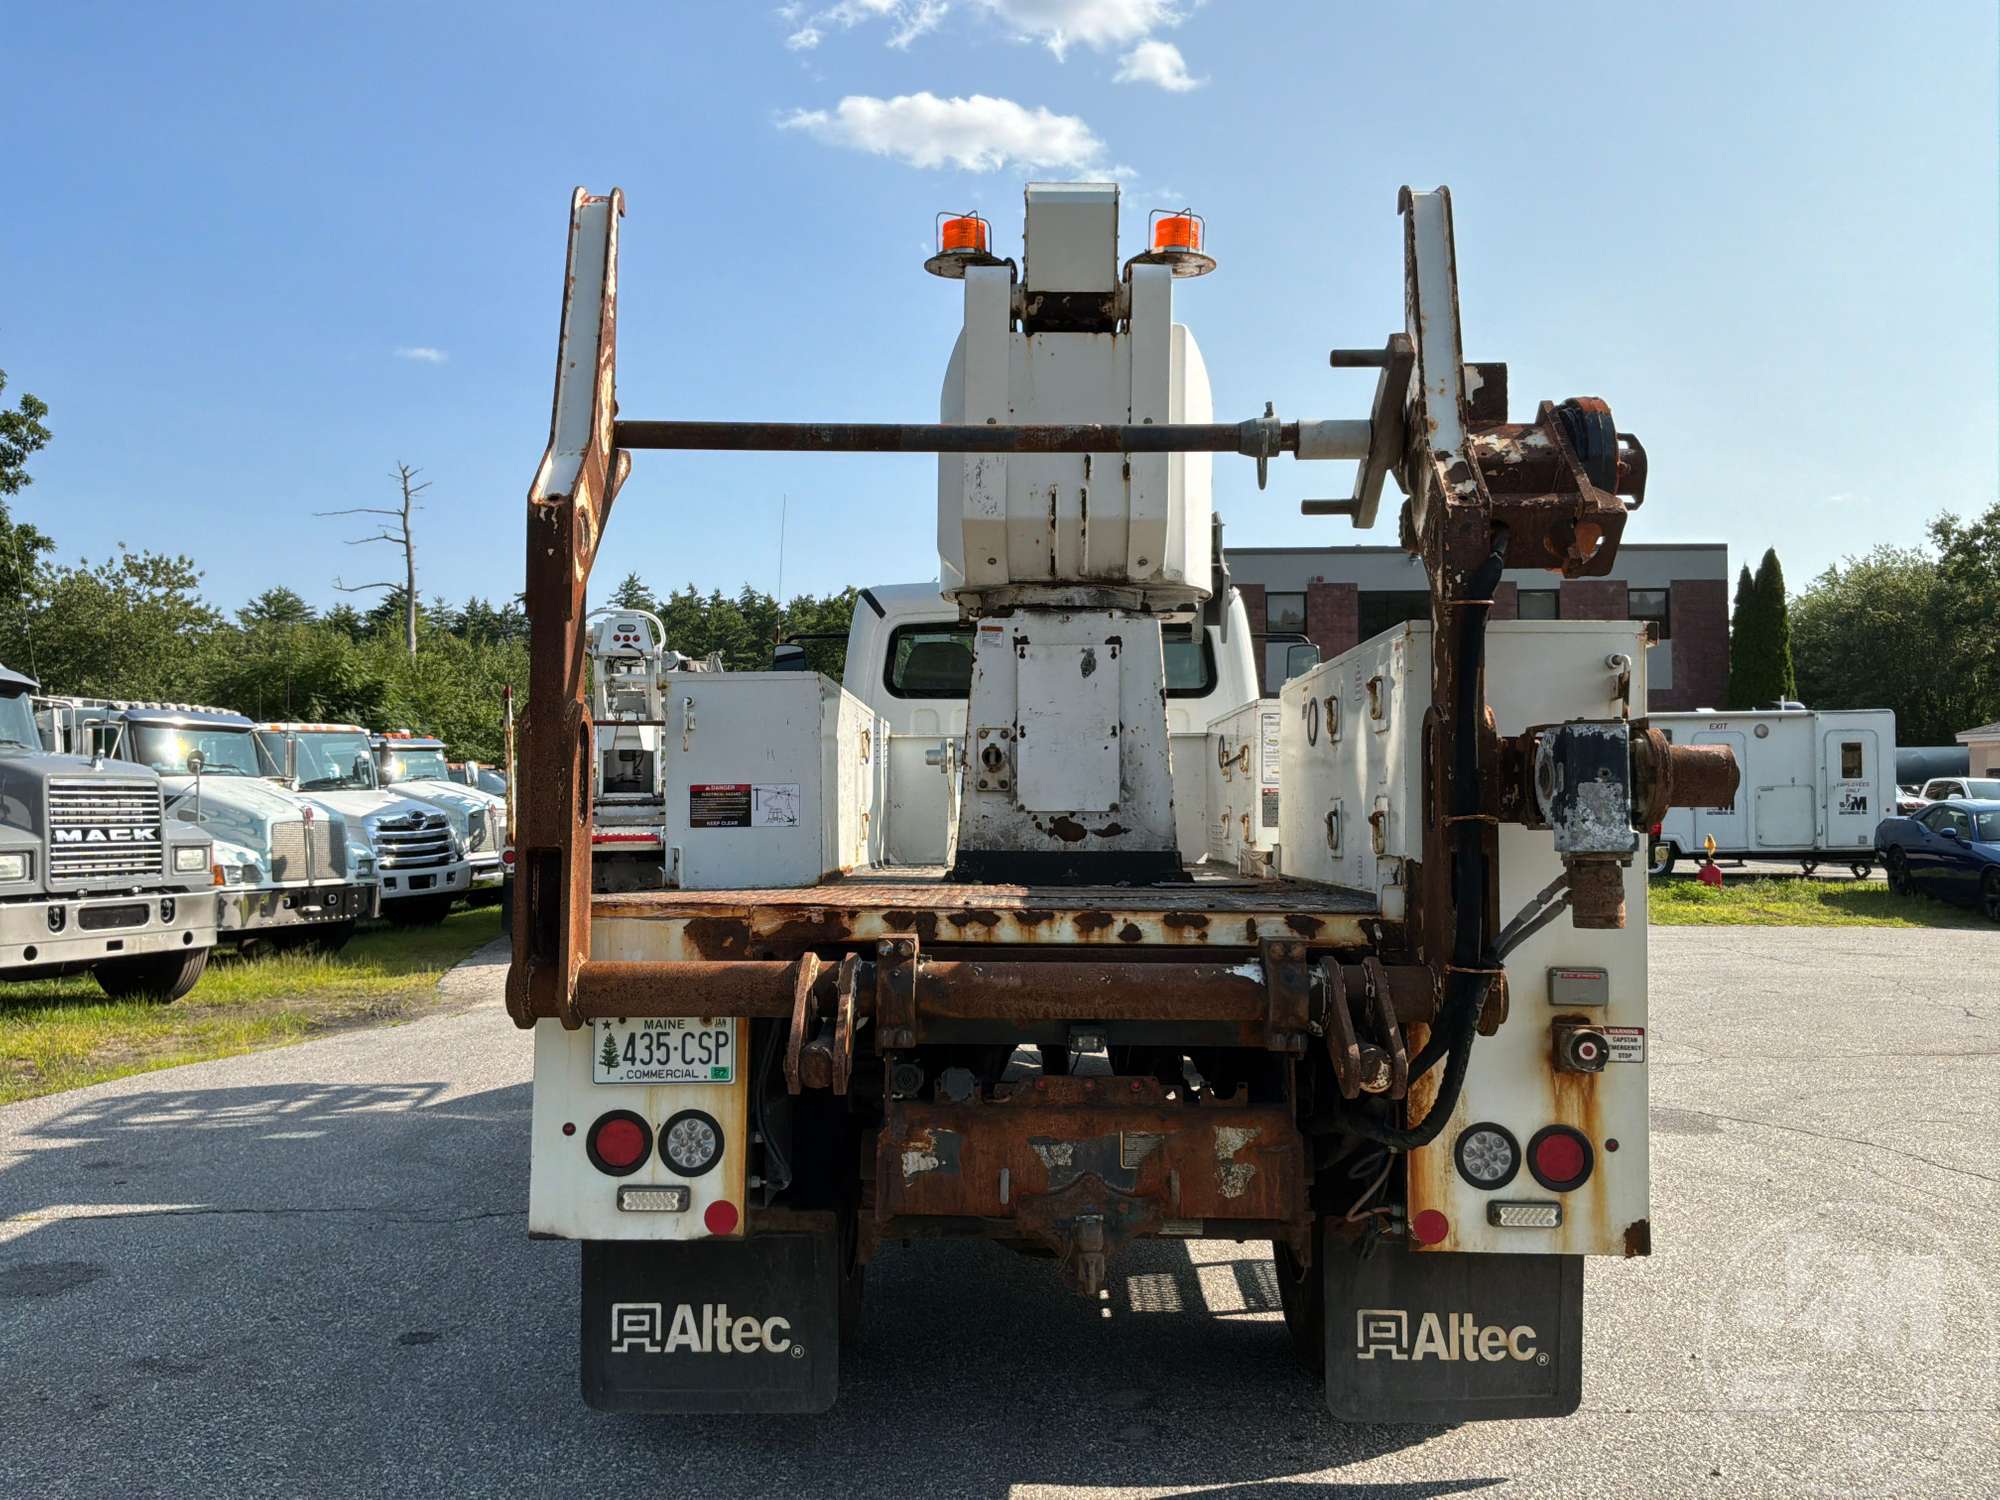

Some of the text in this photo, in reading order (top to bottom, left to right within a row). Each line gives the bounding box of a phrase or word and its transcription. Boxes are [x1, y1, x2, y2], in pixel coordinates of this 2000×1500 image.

[1709, 722, 1728, 730] EXIT
[55, 828, 157, 842] MACK
[643, 1019, 686, 1030] MAINE
[626, 1069, 699, 1080] COMMERCIAL
